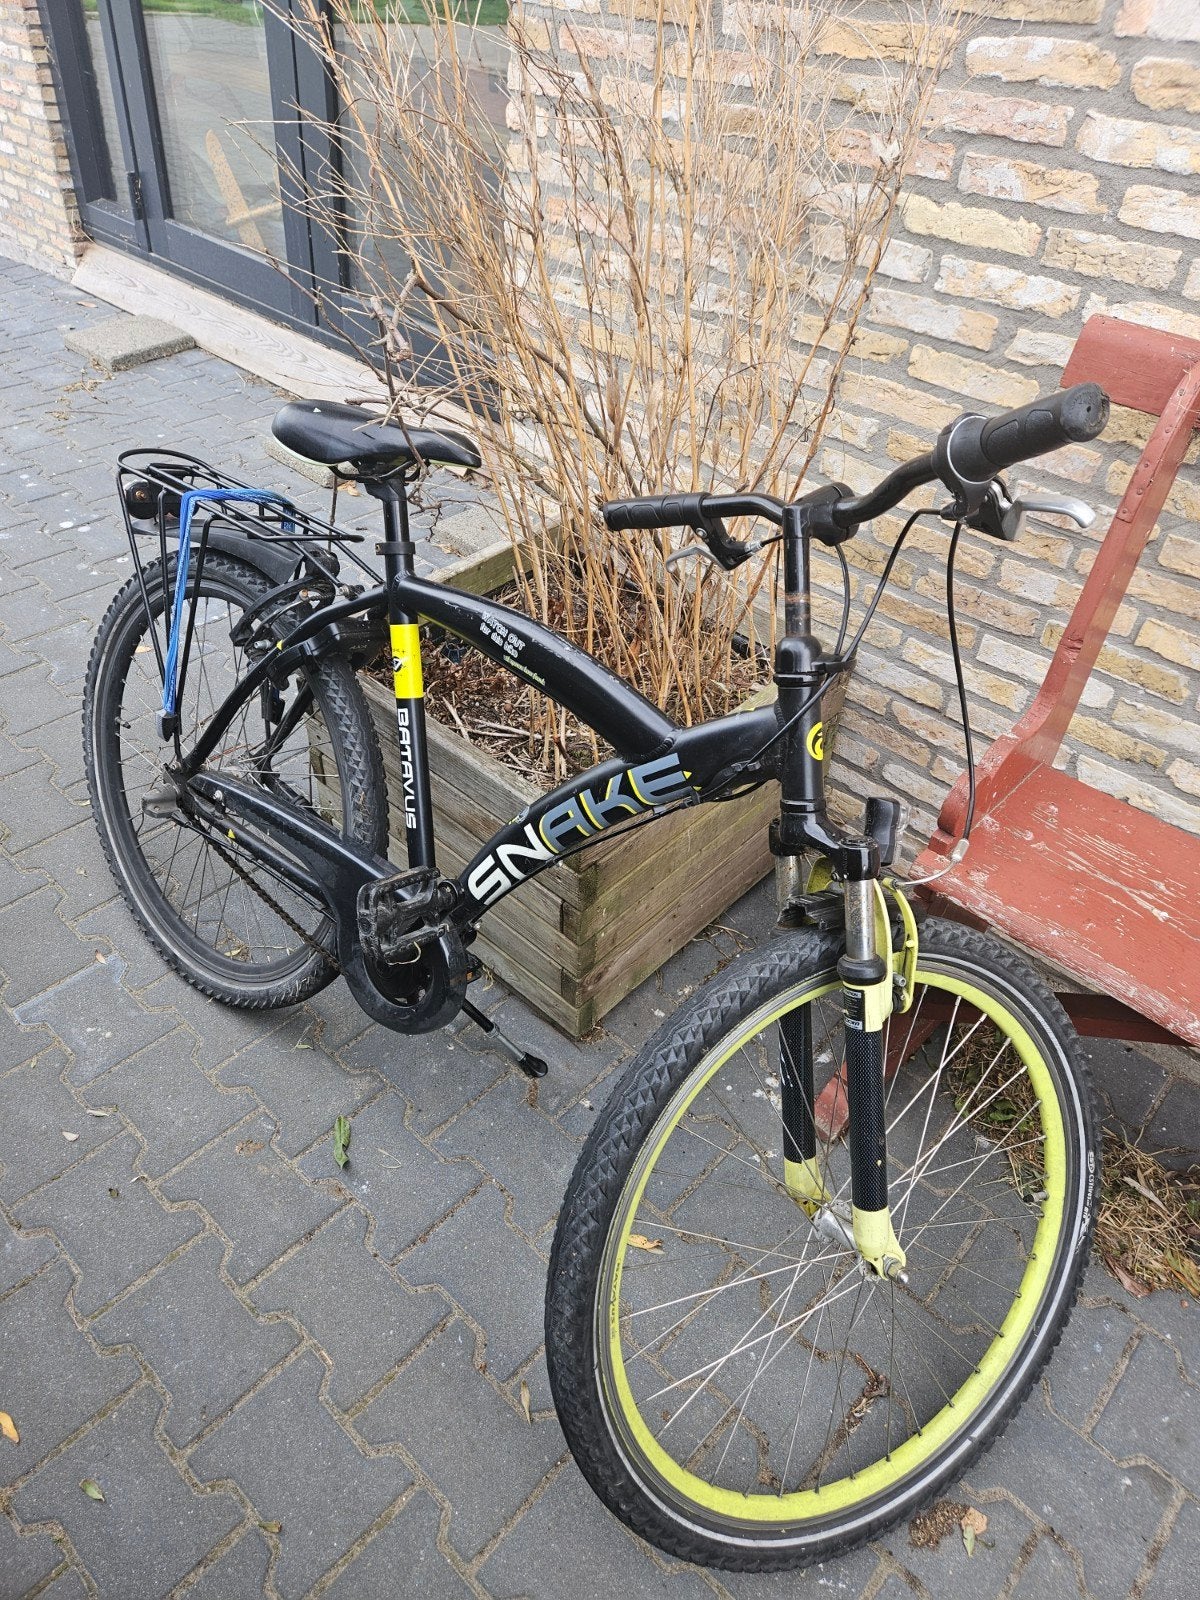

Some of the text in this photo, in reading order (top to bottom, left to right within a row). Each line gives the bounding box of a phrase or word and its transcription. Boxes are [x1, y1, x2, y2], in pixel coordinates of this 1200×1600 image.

[479, 622, 519, 658] for this bike
[481, 611, 525, 650] WATCH OUT
[397, 707, 416, 829] BATAVUS
[467, 753, 702, 905] SNAKE
